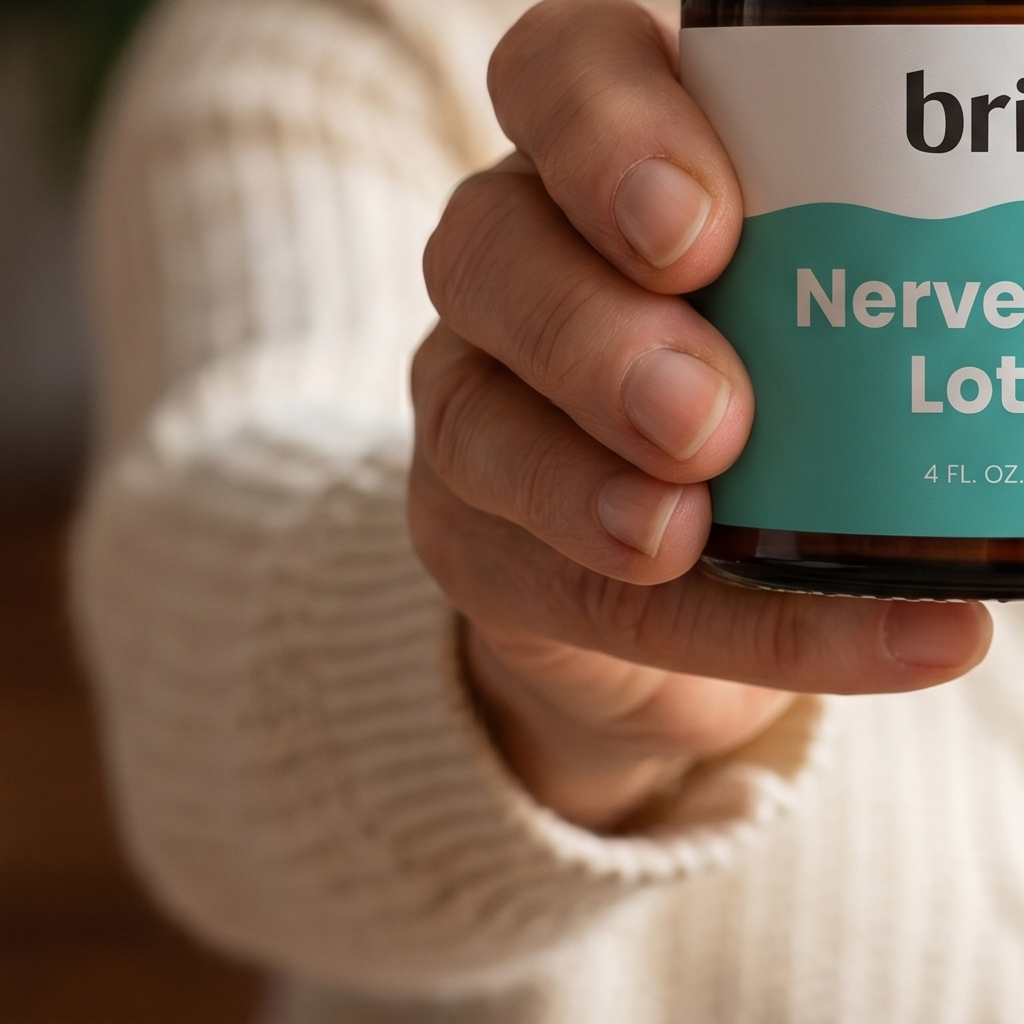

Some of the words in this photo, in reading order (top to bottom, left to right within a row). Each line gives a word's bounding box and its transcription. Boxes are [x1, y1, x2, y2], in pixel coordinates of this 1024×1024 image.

[924, 464, 938, 484] 4
[947, 464, 977, 484] FL.
[984, 464, 1024, 484] OZ.
